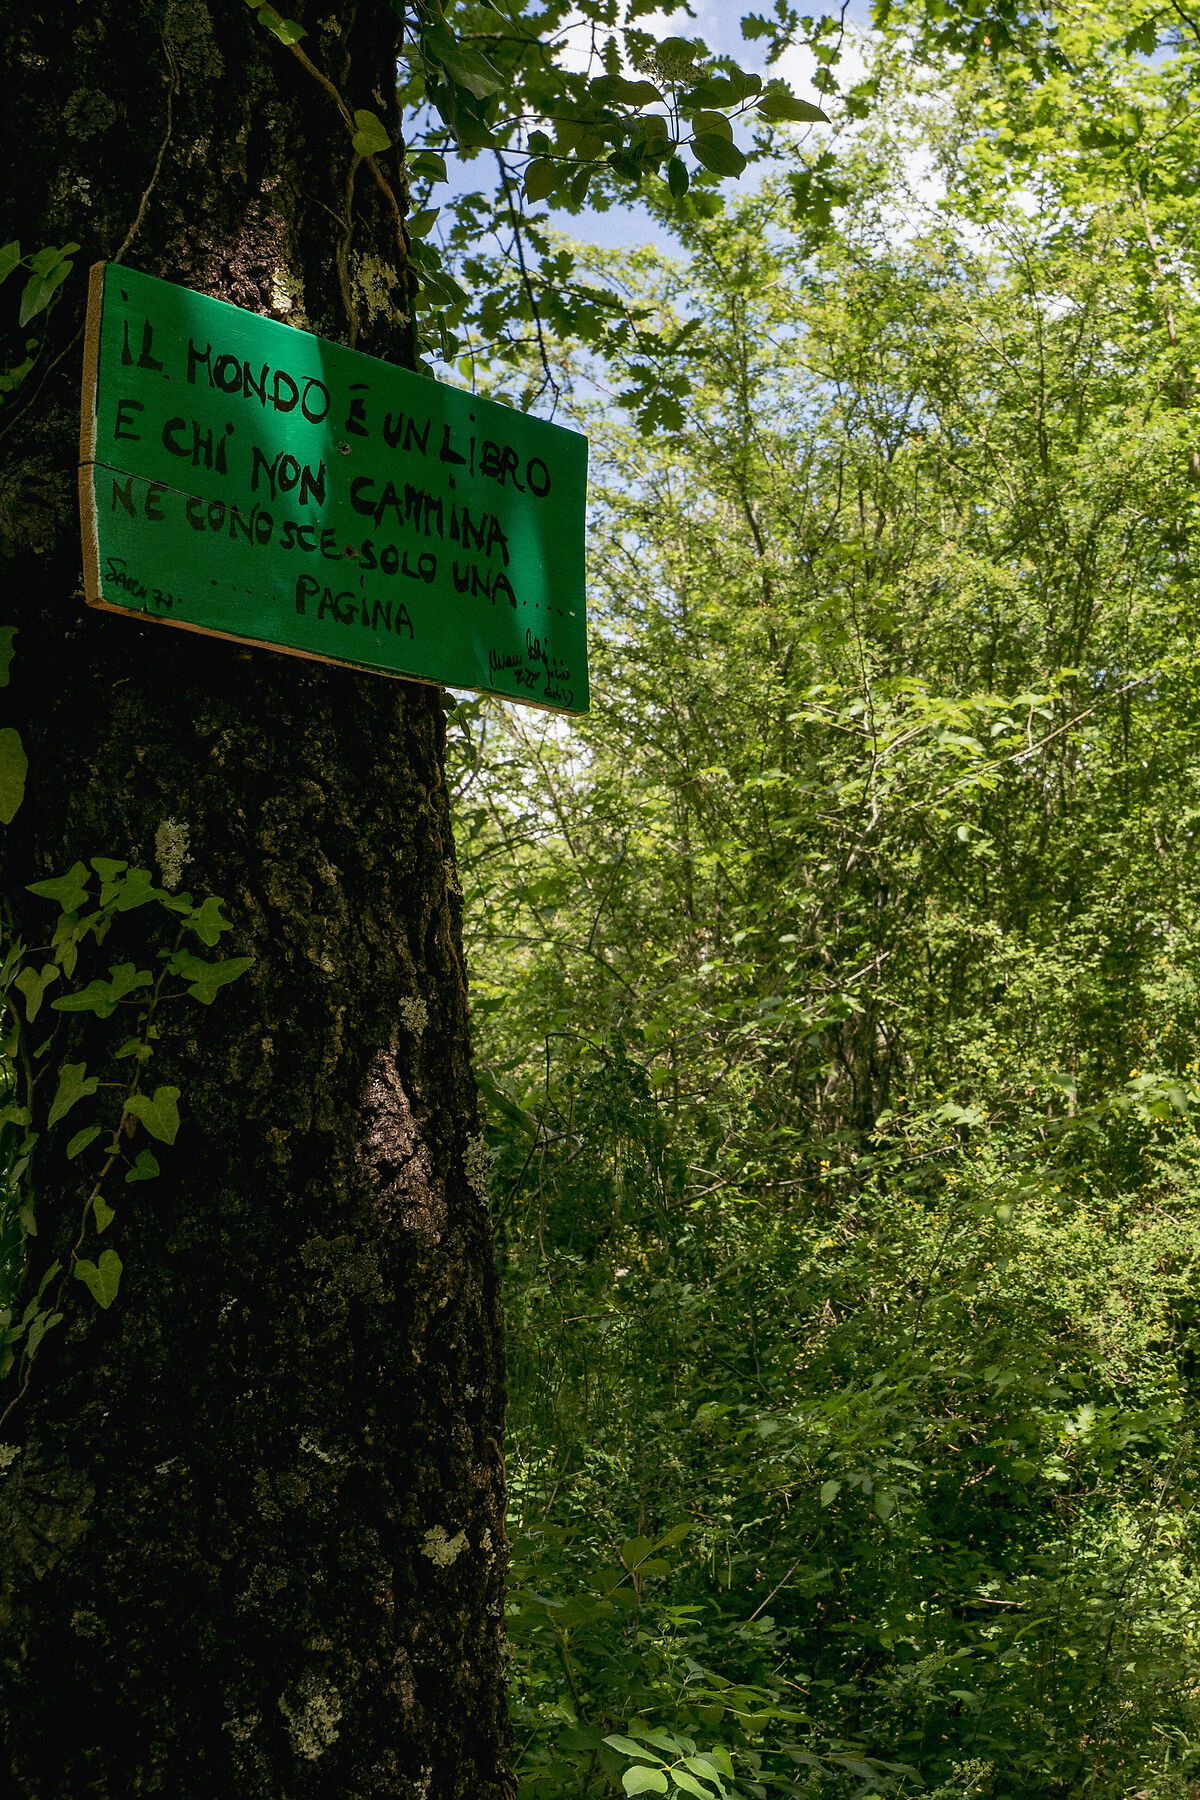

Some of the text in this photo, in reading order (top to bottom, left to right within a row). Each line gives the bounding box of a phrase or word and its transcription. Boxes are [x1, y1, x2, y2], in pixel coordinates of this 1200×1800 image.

[113, 400, 510, 568] E CHI NON CAMMINA
[187, 338, 331, 424] MONDO
[383, 412, 432, 456] UN
[439, 413, 551, 498] LIBRO
[111, 477, 170, 521] NE
[185, 496, 344, 560] CONOSCE
[358, 539, 438, 584] SOLO
[295, 574, 415, 640] PAGINA
